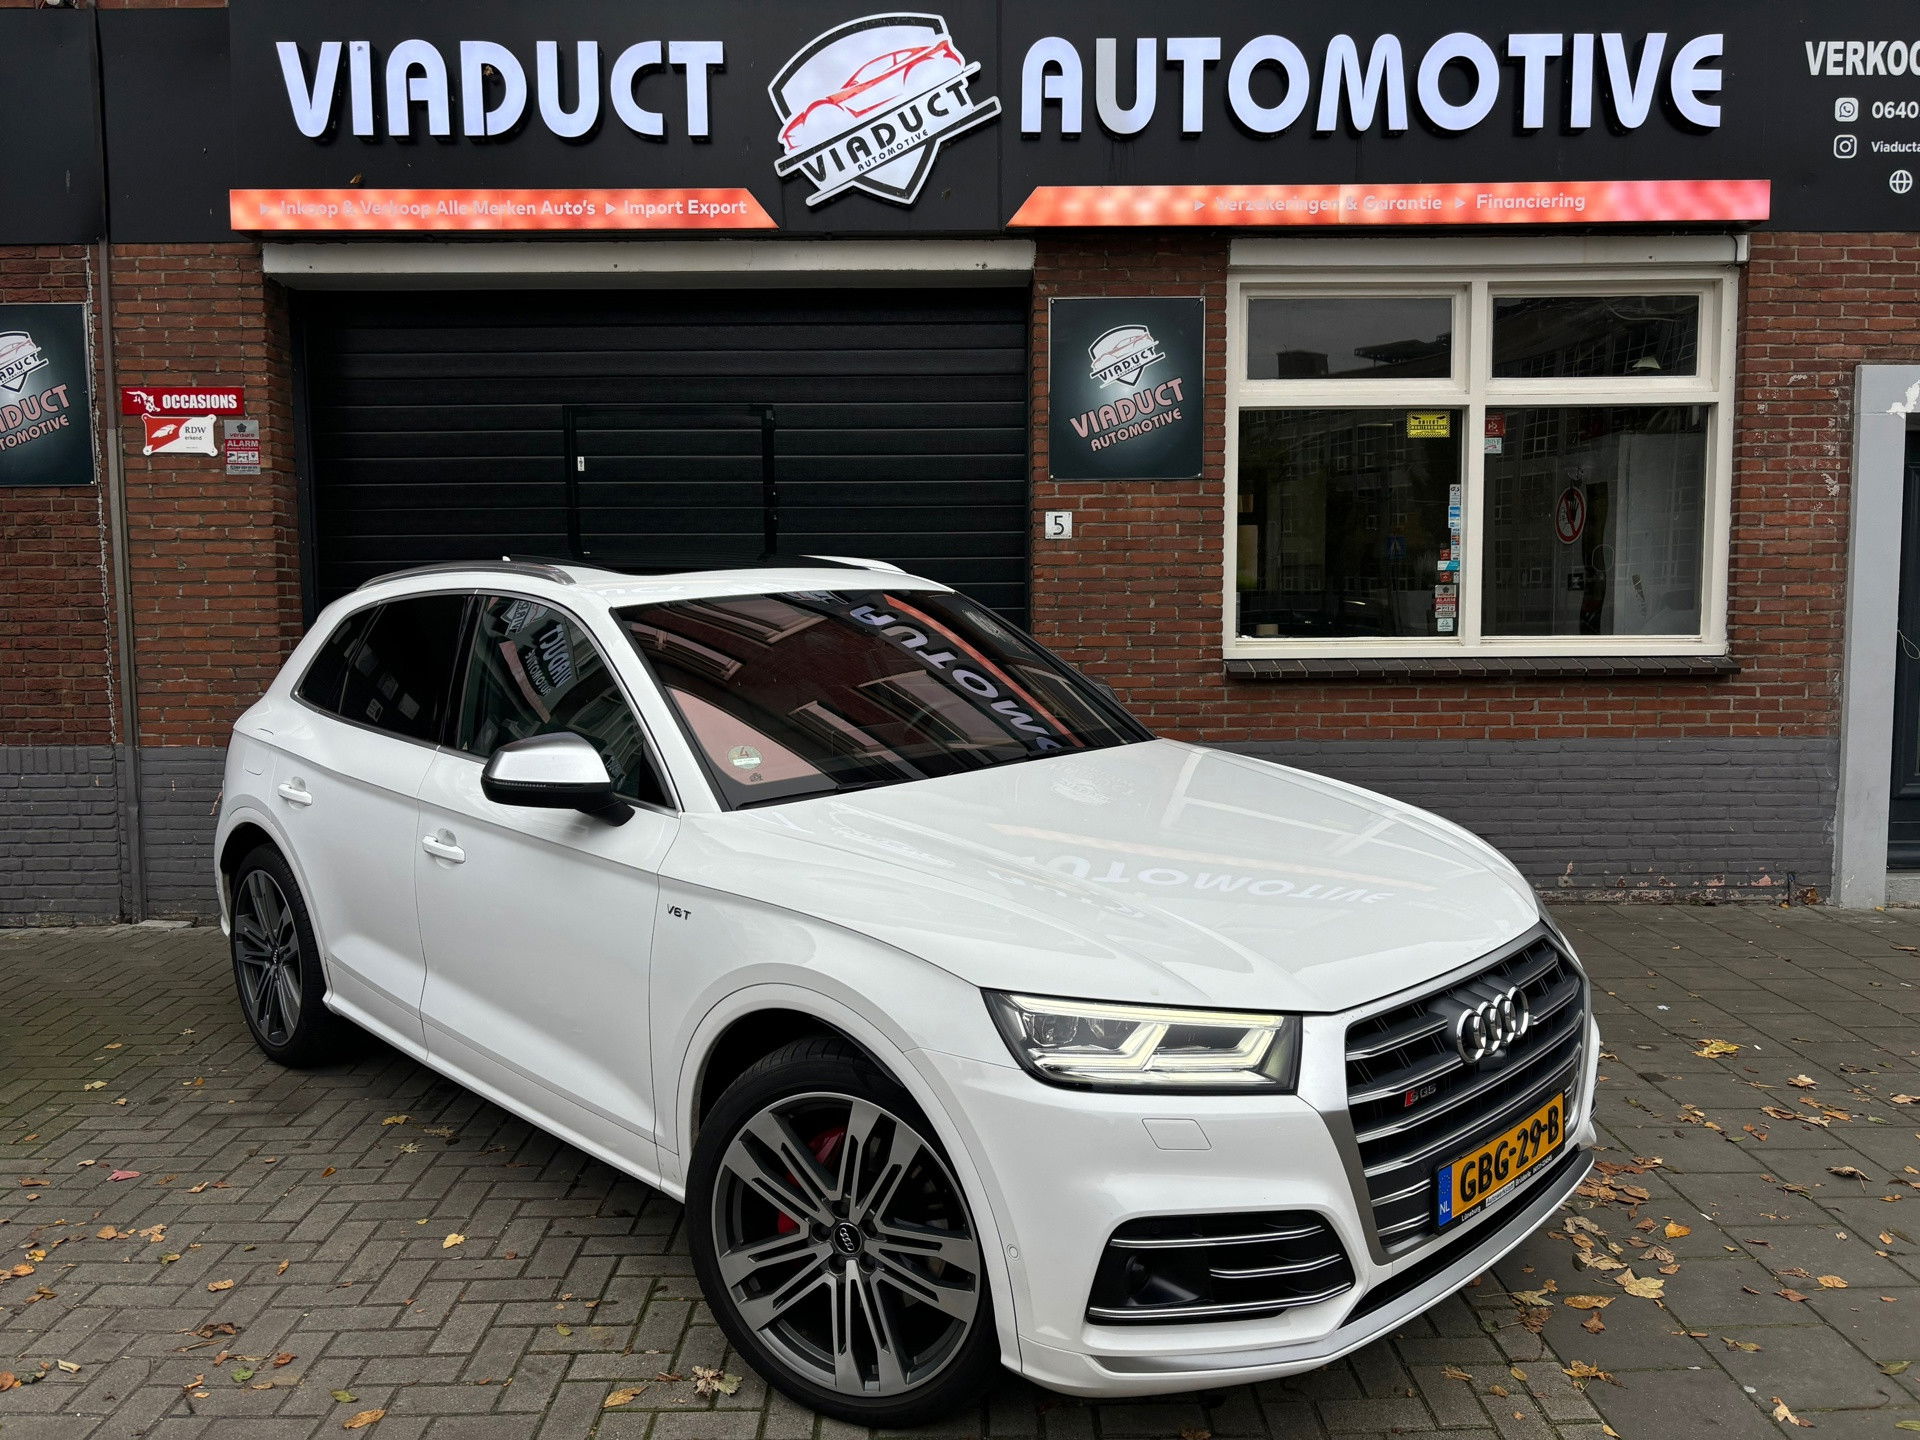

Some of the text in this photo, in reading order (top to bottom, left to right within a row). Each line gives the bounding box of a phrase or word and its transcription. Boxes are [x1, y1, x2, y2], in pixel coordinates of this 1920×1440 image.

[276, 39, 723, 138] VIADUCT
[1021, 32, 1724, 135] AUTOMOTIVE
[1872, 101, 1920, 119] 0640
[803, 80, 968, 182] VIADUCT
[857, 129, 929, 172] AUTOMOTIVE
[281, 199, 747, 218] Inkoop & Verkoop Alle Merken Auto's Import Export
[1346, 196, 1358, 211] &
[1363, 195, 1442, 211] Garantie
[1476, 193, 1586, 212] Financiering
[1099, 346, 1155, 381] VIADUCT
[162, 394, 237, 409] OCCASIONS
[1070, 378, 1184, 438] VIADUCT
[185, 426, 207, 434] RDW
[1090, 407, 1183, 452] AUTOMOTIVE
[1053, 515, 1065, 536] 5
[667, 903, 692, 921] V6T
[1439, 1201, 1451, 1216] NL
[1460, 1105, 1559, 1203] GBG-29-B
